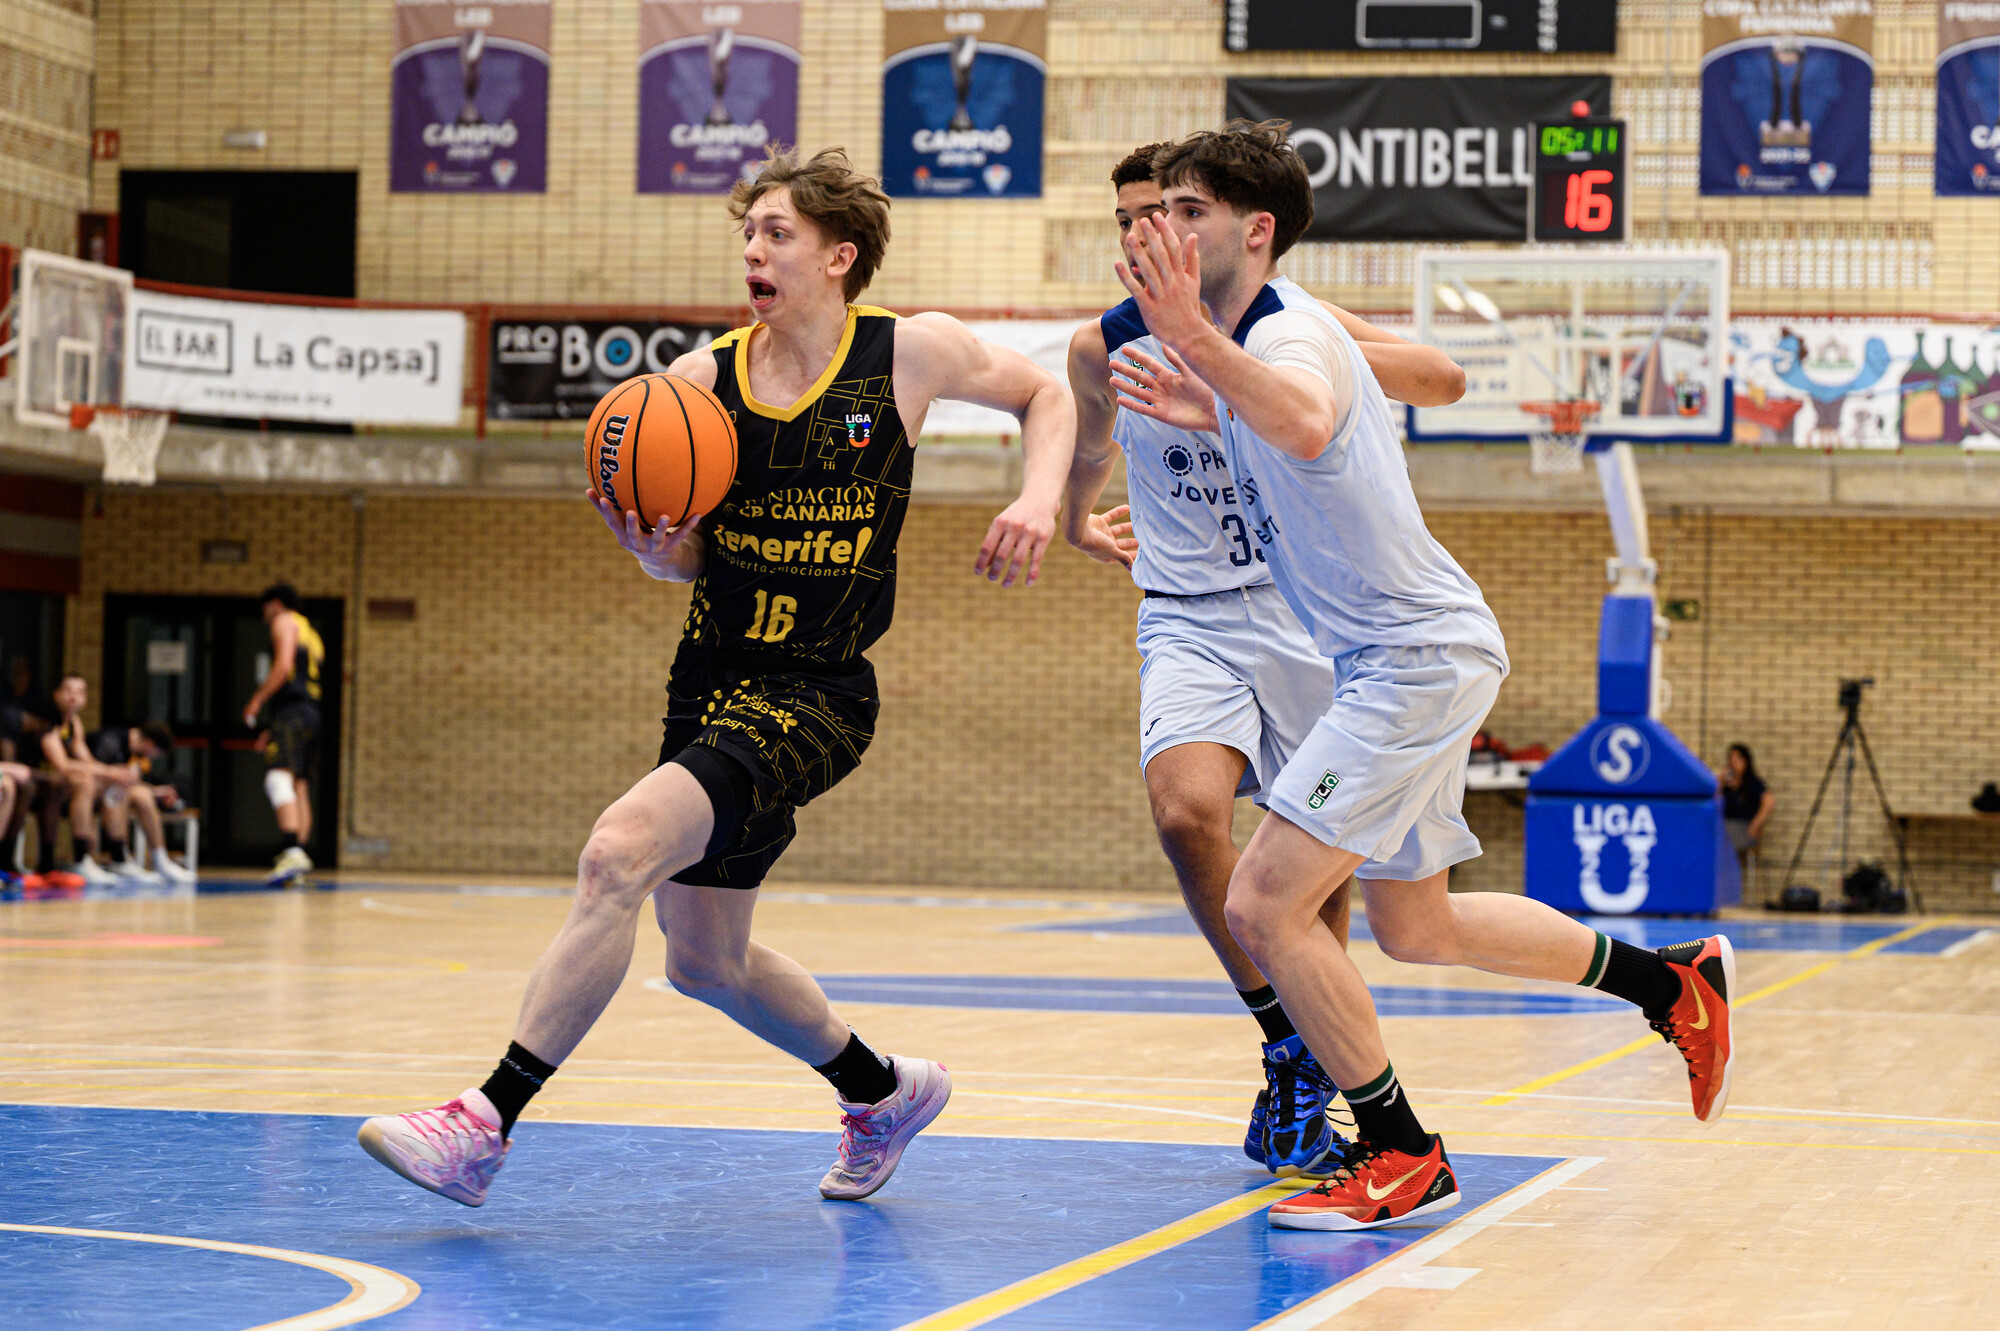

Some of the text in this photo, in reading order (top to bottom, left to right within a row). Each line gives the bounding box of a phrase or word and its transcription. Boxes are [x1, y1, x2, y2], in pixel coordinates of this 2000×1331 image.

[422, 119, 519, 148] CAMPIÓ
[670, 119, 769, 149] CAMPIÓ
[911, 124, 1013, 154] CAMPIÓ
[1564, 170, 1613, 232] 16
[144, 326, 165, 356] EL
[173, 328, 219, 360] BAR
[254, 332, 294, 369] La
[498, 325, 558, 351] PRO
[845, 414, 872, 423] LIGA
[600, 415, 631, 511] Wilson
[771, 502, 876, 522] CANARIAS
[745, 589, 798, 643] 16
[1573, 803, 1658, 837] LIGA
